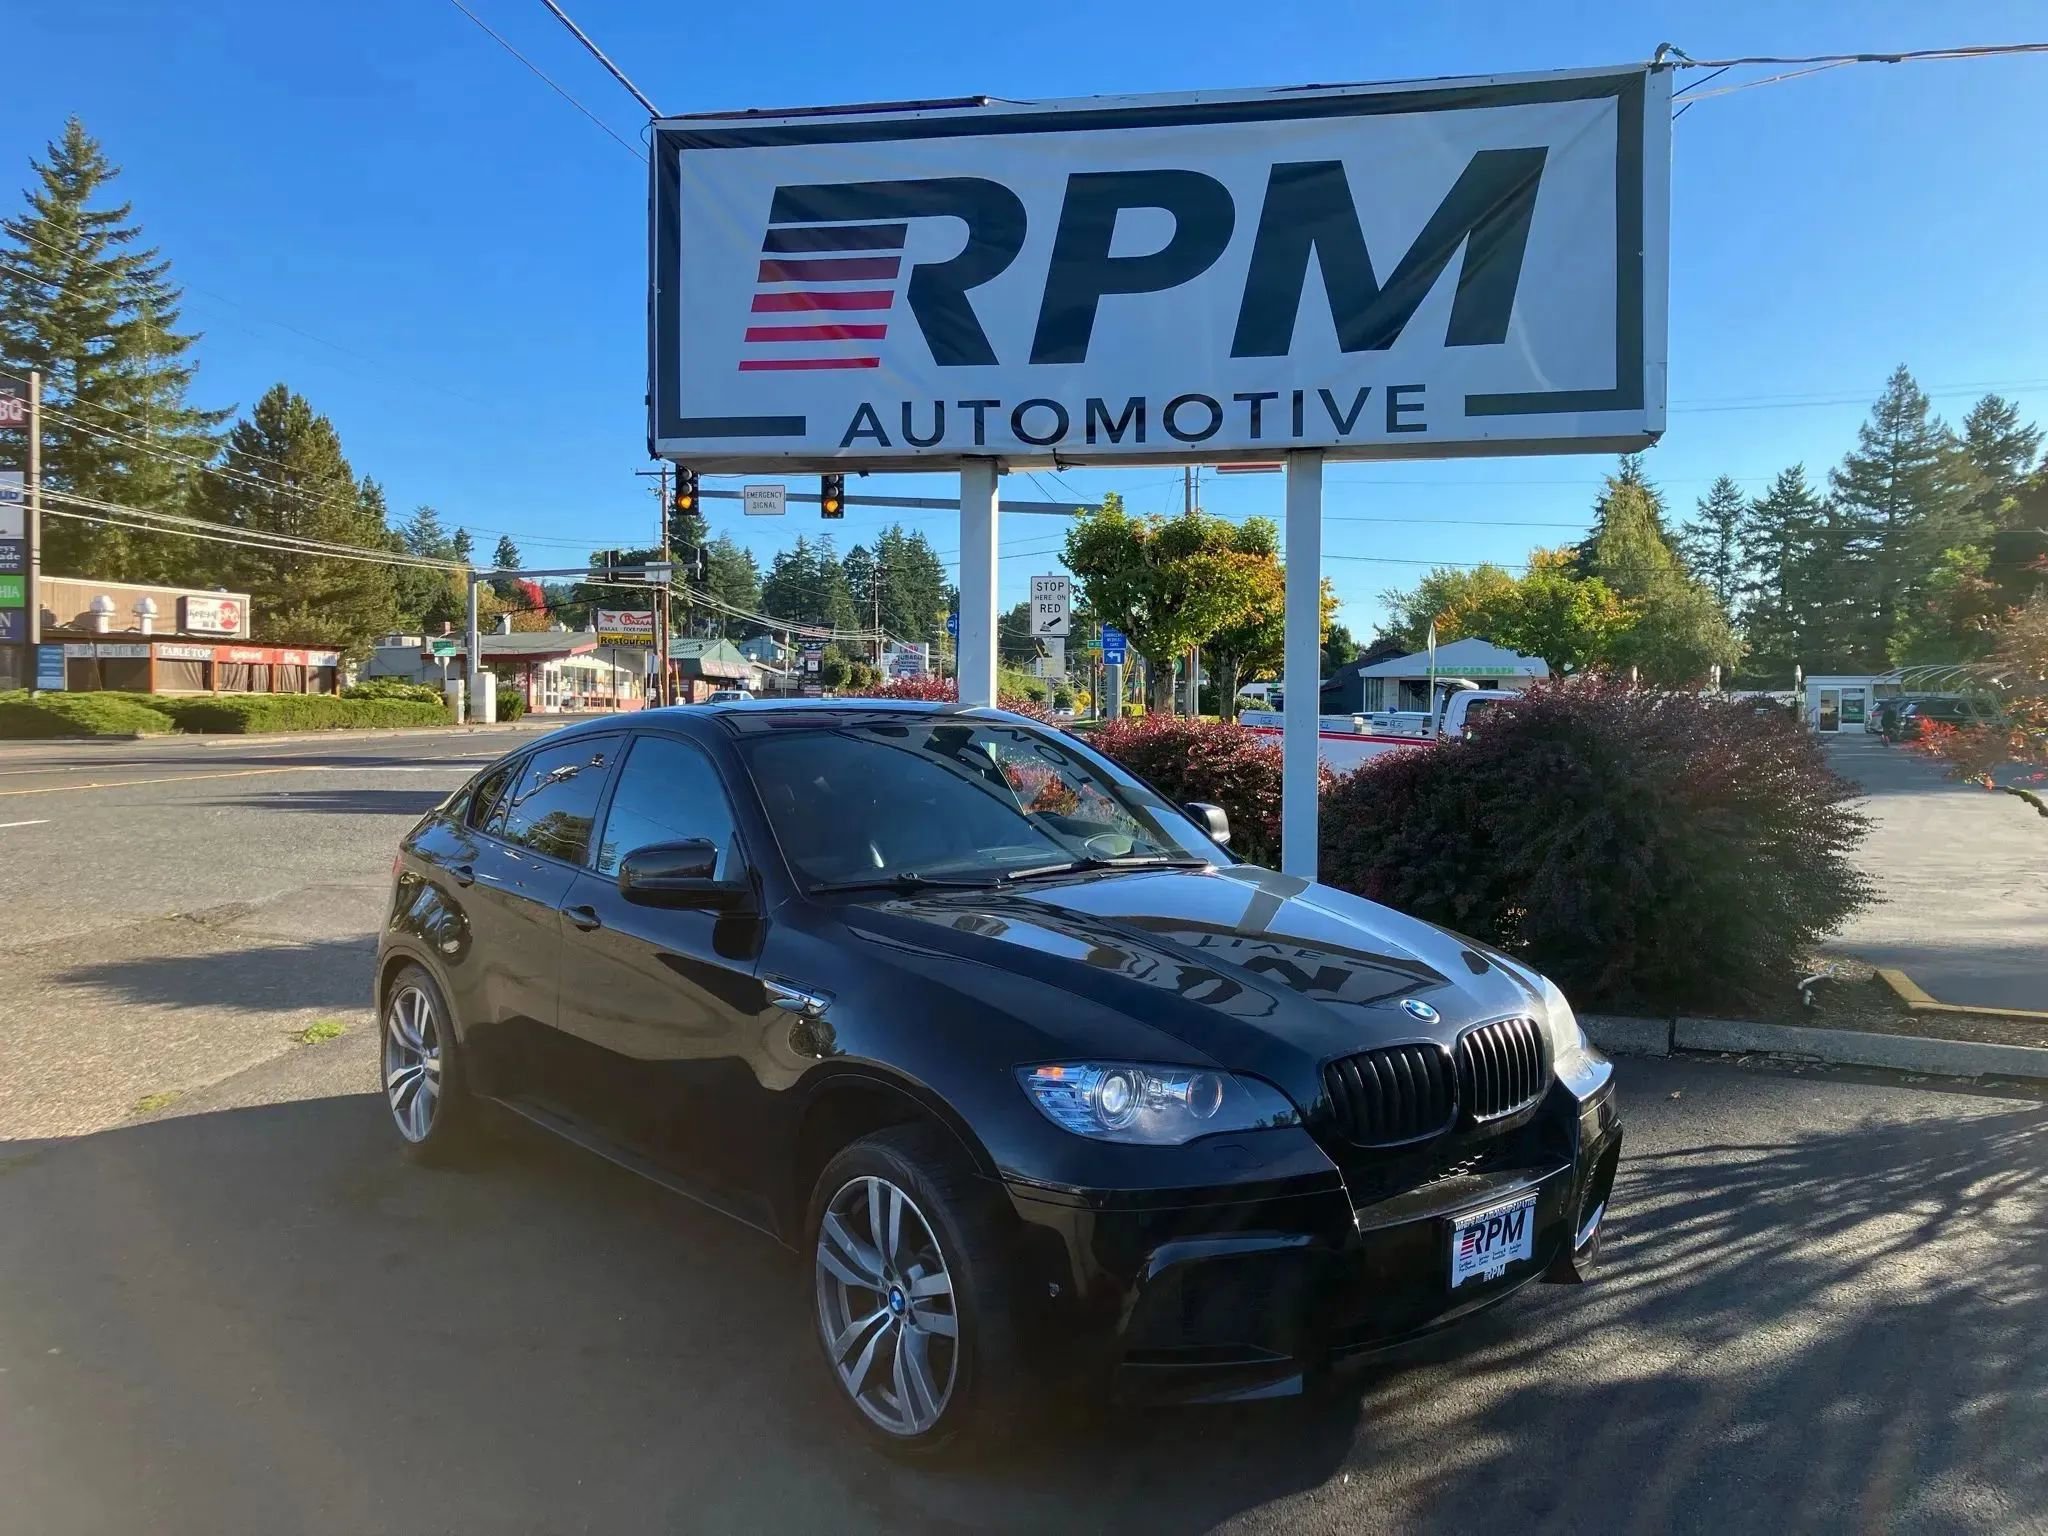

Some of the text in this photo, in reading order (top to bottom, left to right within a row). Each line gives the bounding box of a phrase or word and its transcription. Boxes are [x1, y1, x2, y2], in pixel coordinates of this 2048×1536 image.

[739, 146, 1549, 371] RPM
[840, 383, 1428, 449] AUTOMOTIVE
[746, 491, 782, 499] EMERGENCY
[752, 501, 777, 509] SIGNAL
[1036, 581, 1065, 592] STOP
[1039, 603, 1061, 613] RED
[600, 636, 652, 646] Restauran
[1460, 1209, 1526, 1260] RPM
[1483, 1263, 1507, 1282] RPM
